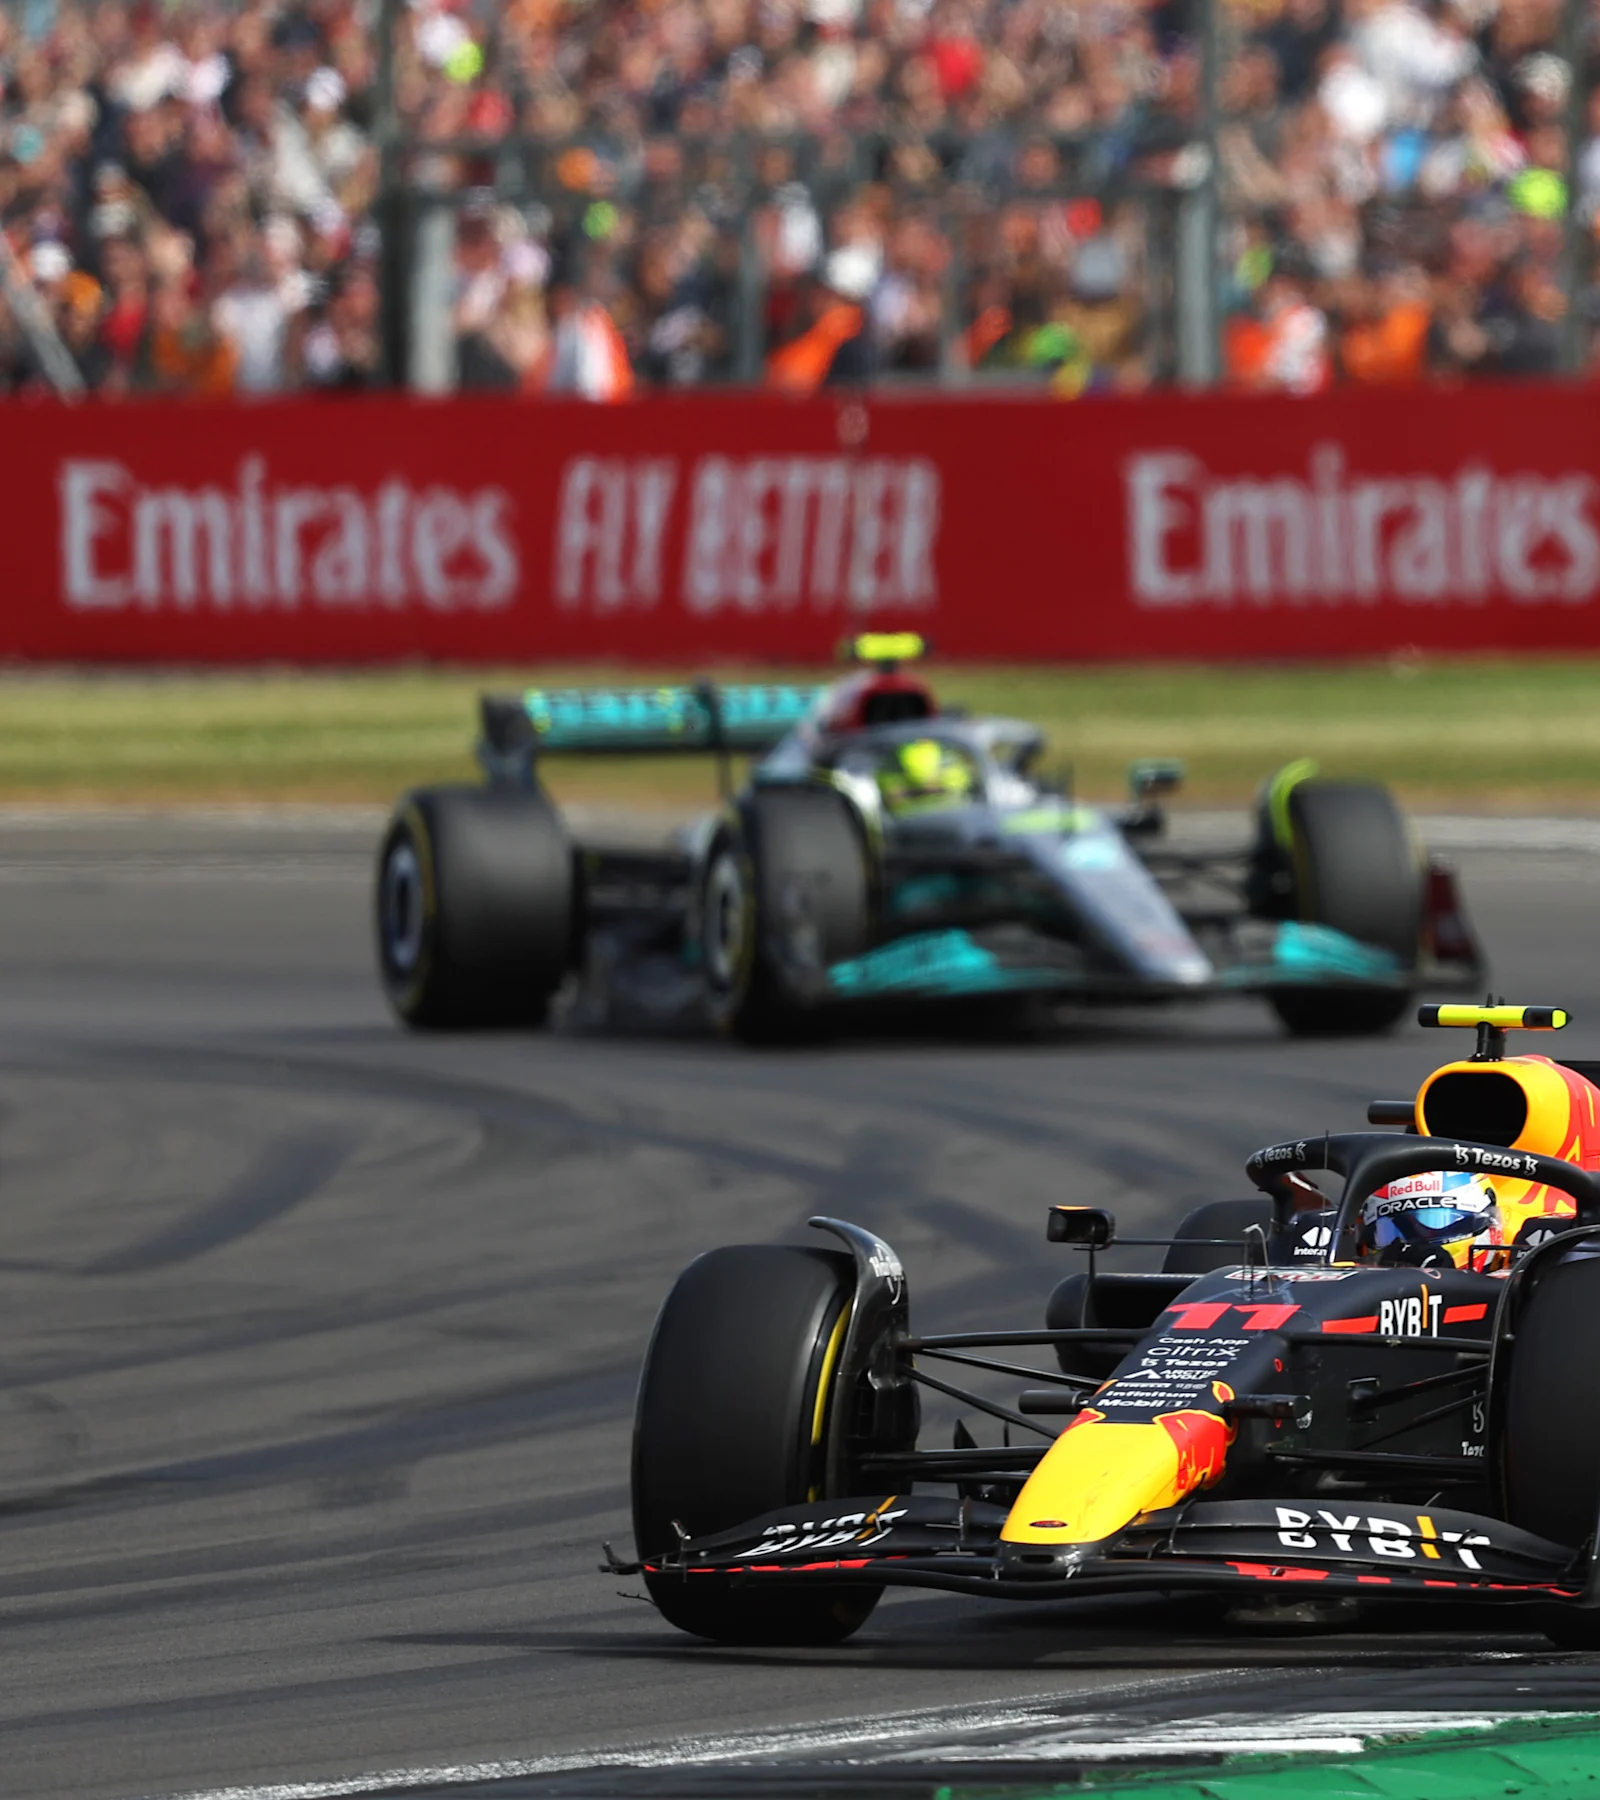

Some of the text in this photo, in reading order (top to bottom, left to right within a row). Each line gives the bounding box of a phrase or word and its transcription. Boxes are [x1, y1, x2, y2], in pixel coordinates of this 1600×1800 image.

[59, 450, 938, 608] Emirates FLY BETTER
[1264, 1147, 1293, 1162] Tezos
[1473, 1149, 1521, 1170] Tezos
[1390, 1180, 1440, 1198] Red Bull
[1378, 1197, 1456, 1217] ORACLE
[1166, 1303, 1302, 1330] 11
[1381, 1284, 1442, 1337] BYBIT
[1164, 1359, 1229, 1367] Tezos
[733, 1495, 908, 1558] BYBIT
[1275, 1507, 1490, 1569] BYBIT
